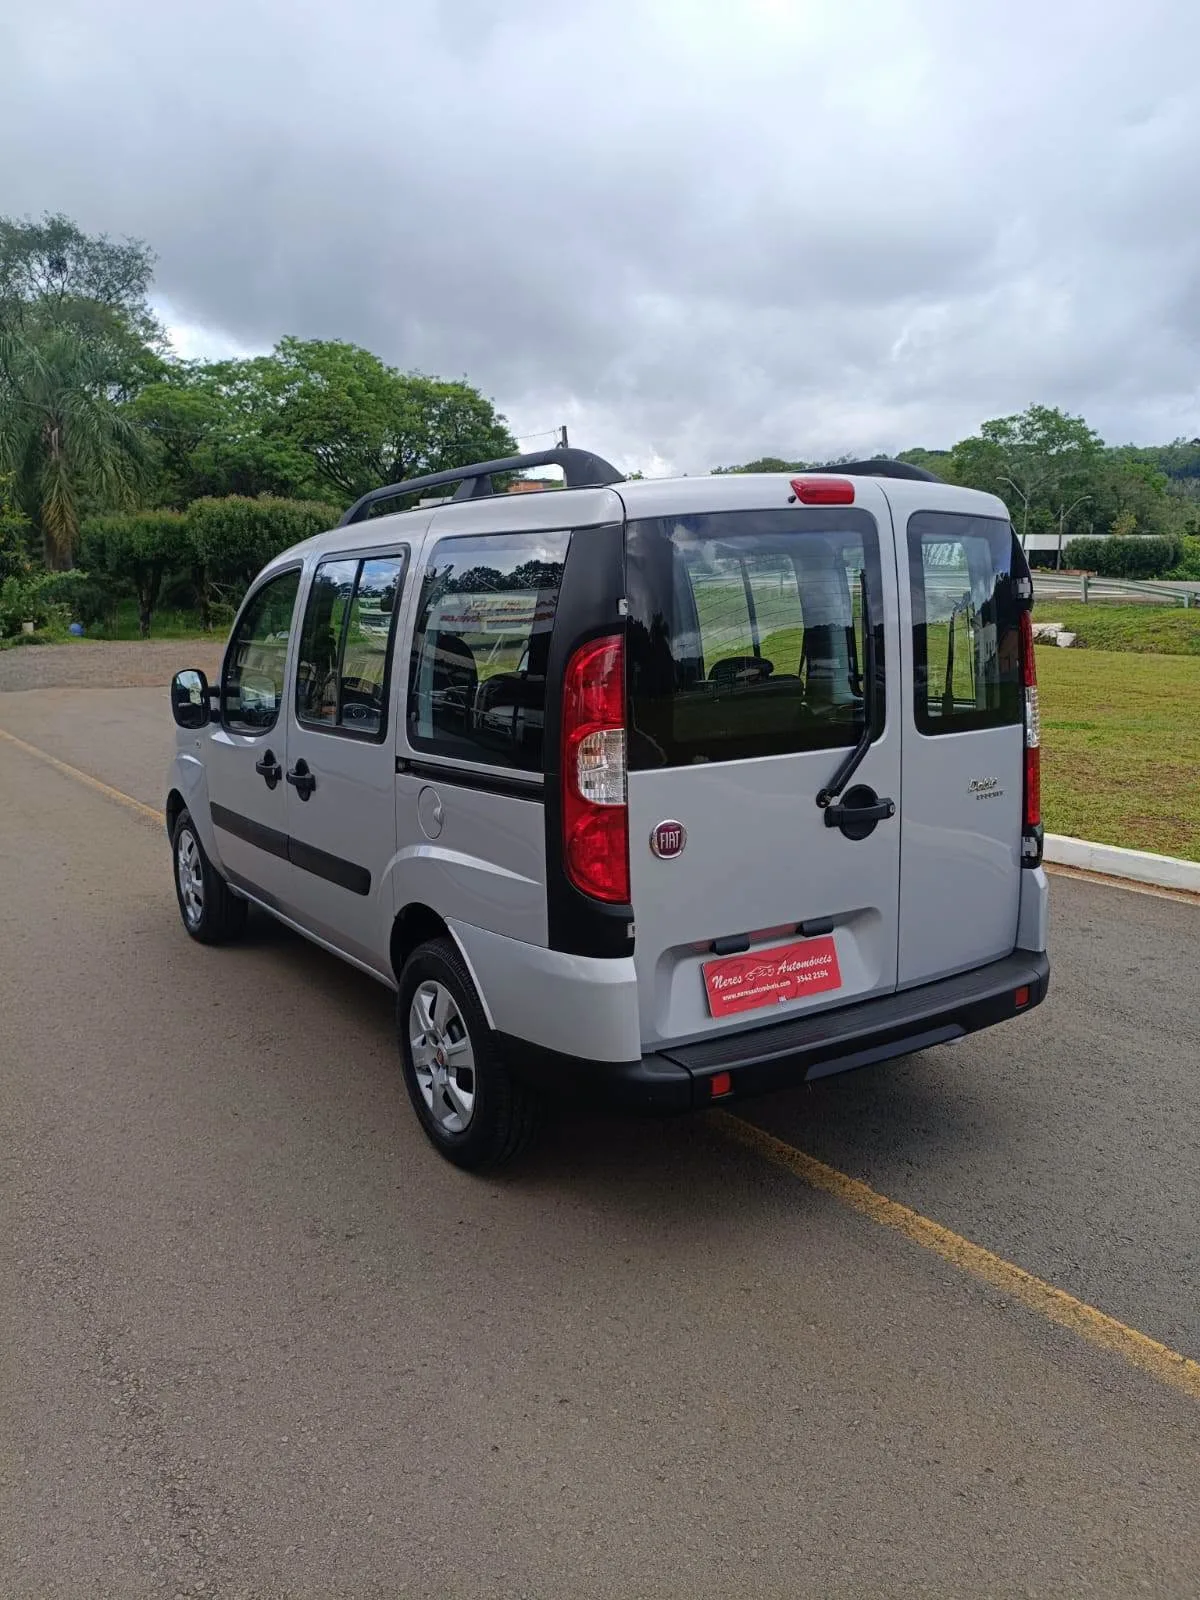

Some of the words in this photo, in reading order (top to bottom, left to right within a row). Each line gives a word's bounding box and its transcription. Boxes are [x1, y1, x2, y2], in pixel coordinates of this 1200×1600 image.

[660, 830, 681, 850] FIAT
[712, 974, 742, 989] Neres
[777, 955, 833, 975] Automóveis
